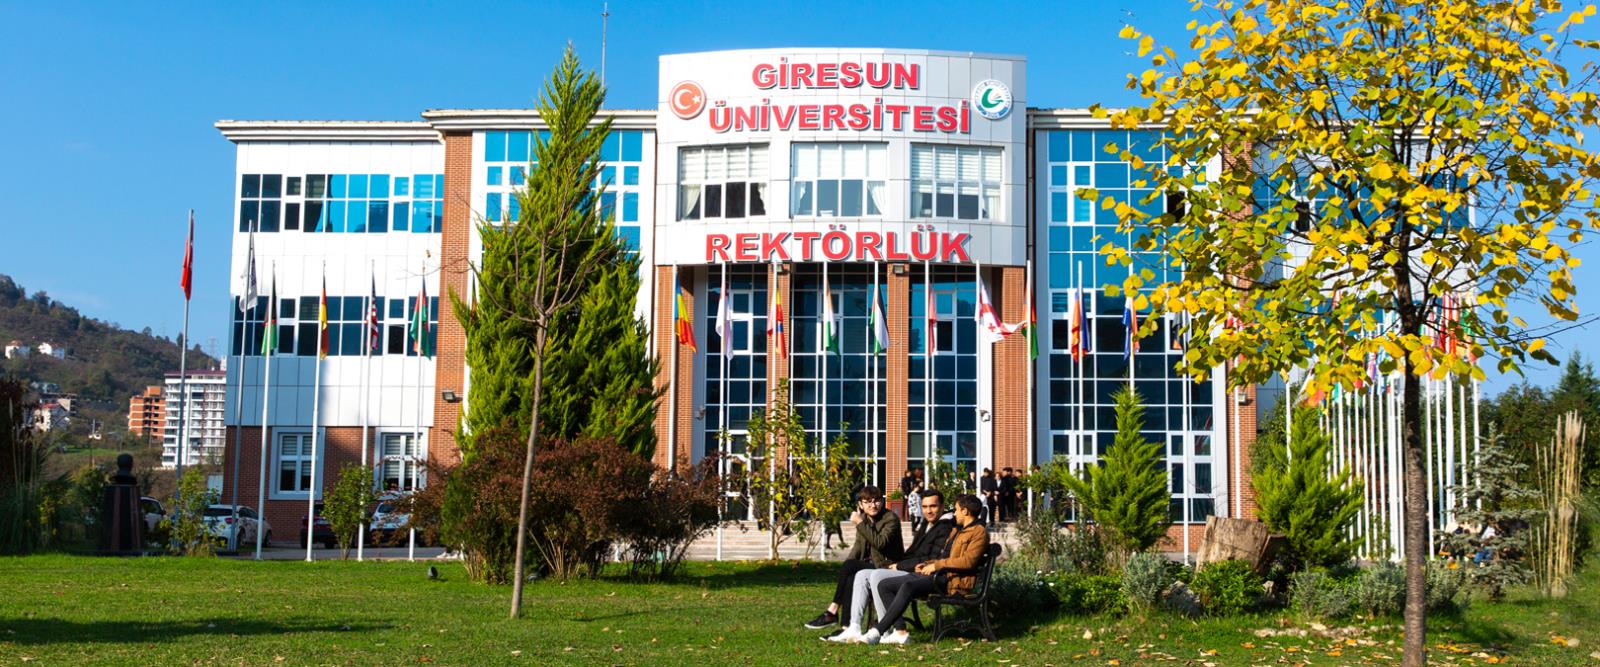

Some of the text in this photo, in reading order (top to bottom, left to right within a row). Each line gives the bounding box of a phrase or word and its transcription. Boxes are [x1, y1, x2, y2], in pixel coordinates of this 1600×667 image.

[752, 57, 919, 90] GİRESUN
[709, 97, 970, 134] ÜNİVERSİTESİ
[705, 223, 971, 263] REKTÖRLÜK
